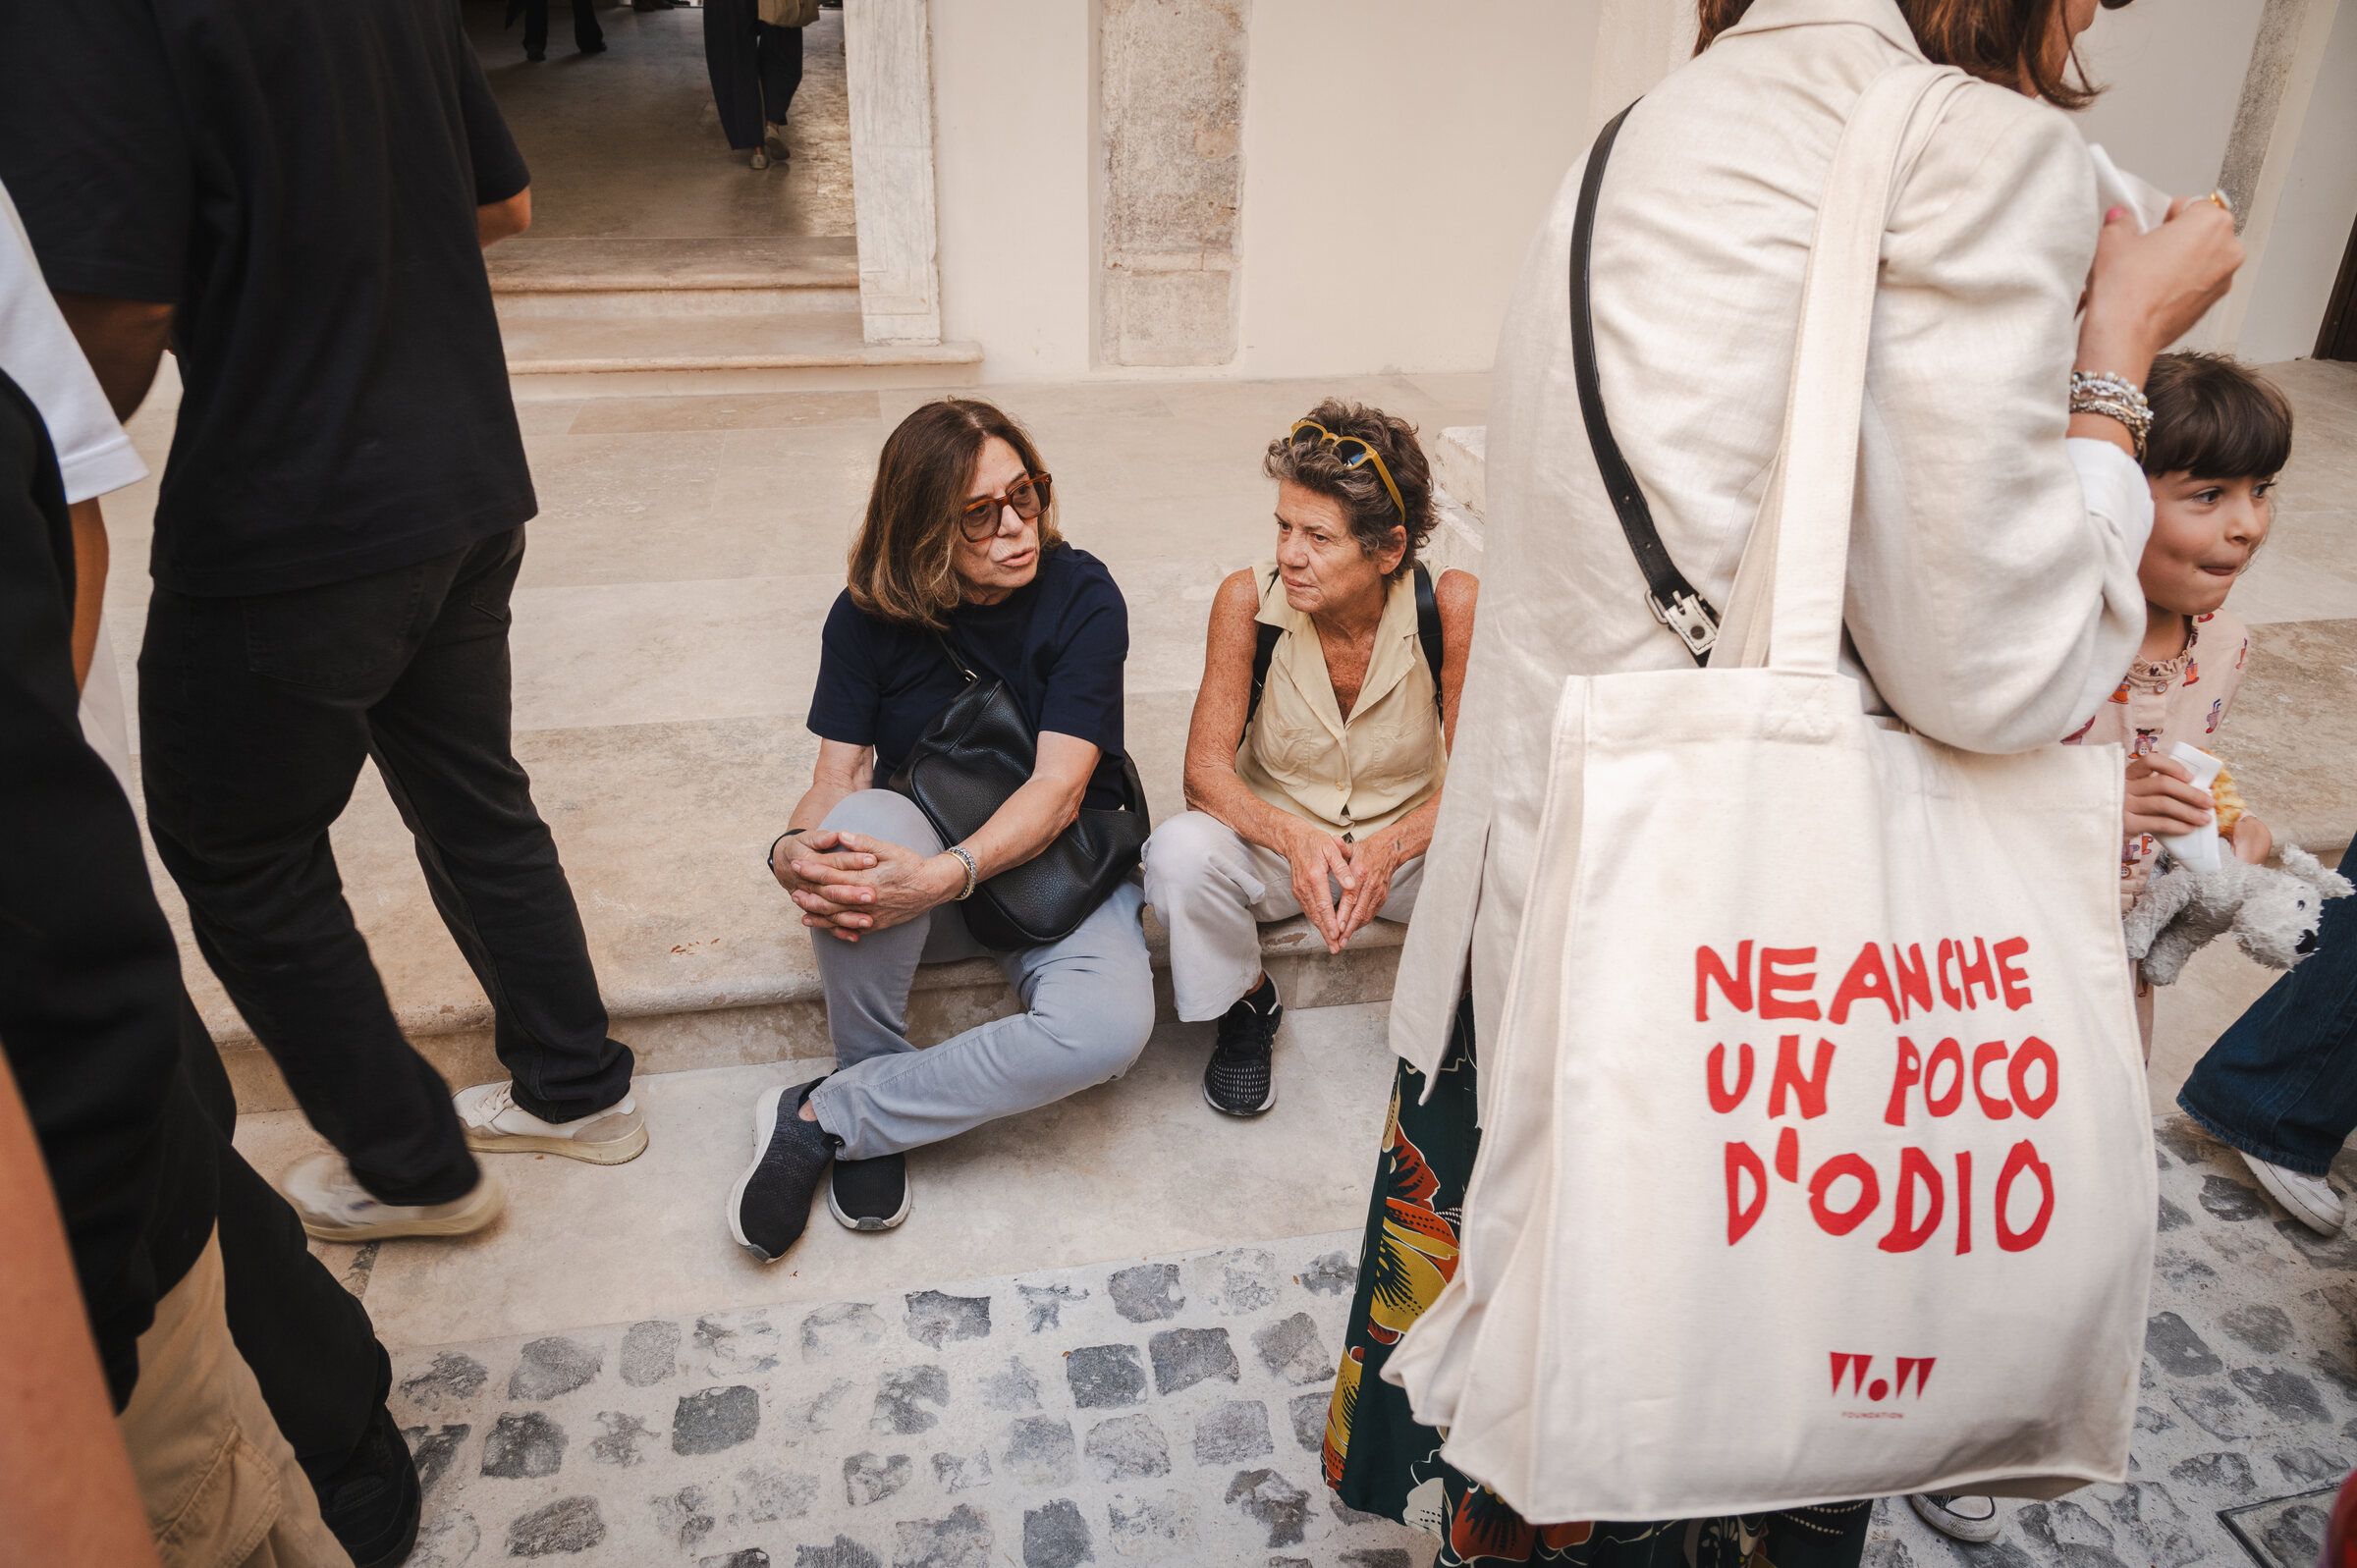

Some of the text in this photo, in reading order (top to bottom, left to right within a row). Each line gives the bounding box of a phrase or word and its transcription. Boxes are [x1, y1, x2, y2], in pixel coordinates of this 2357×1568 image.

[1694, 936, 2032, 1026] NEANCHE
[1706, 1034, 2058, 1128] UN POCO
[1724, 1125, 2056, 1257] D'ODIO
